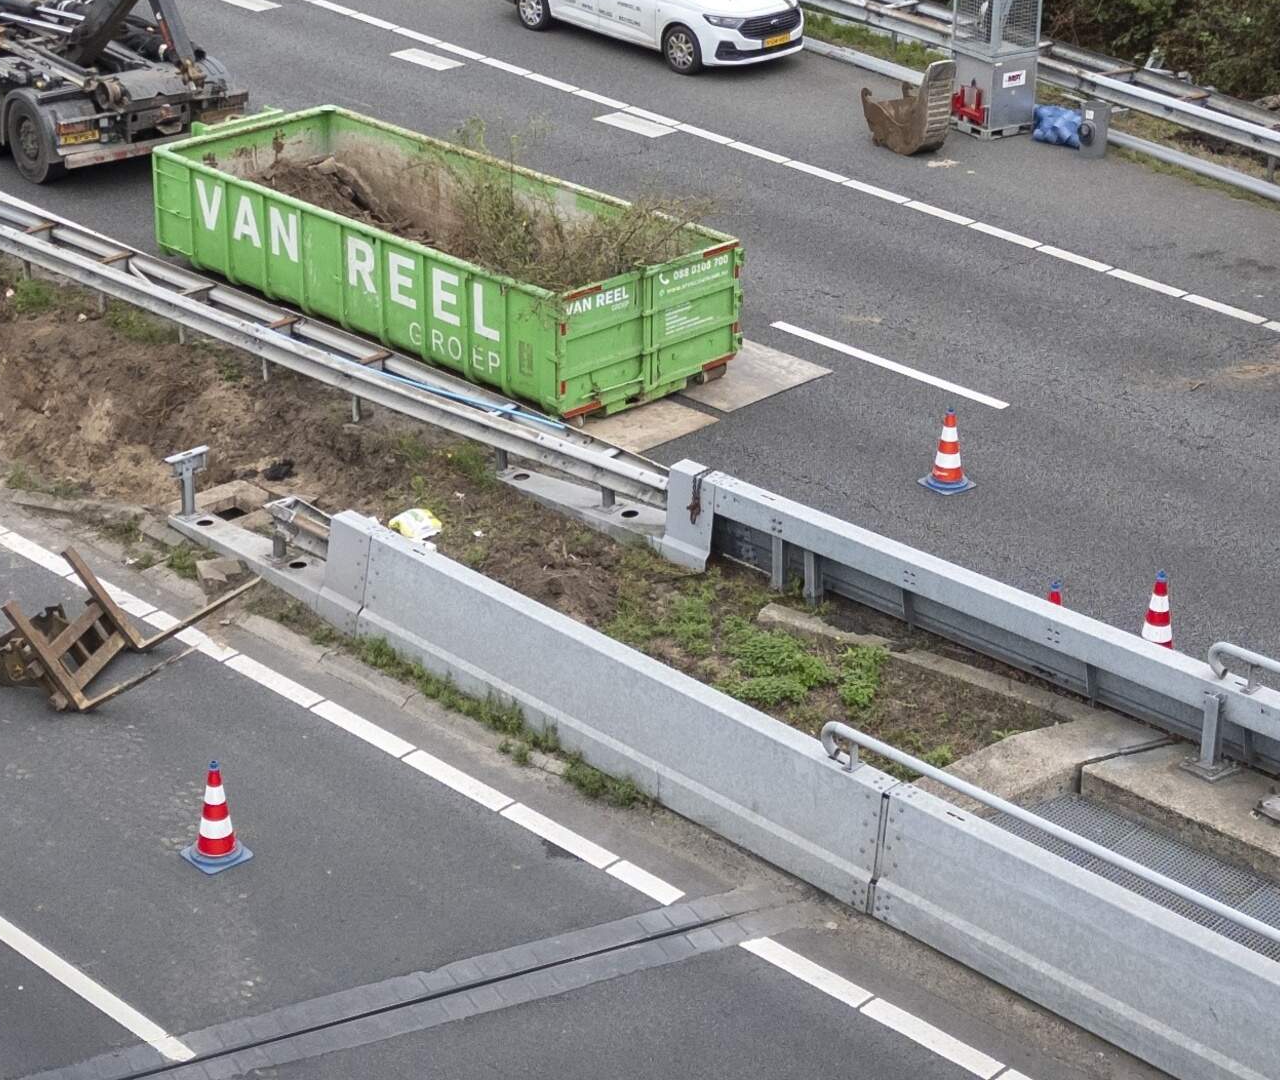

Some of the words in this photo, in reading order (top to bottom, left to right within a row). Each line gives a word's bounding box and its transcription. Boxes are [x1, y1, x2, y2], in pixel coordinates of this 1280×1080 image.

[196, 178, 299, 263] VAN
[346, 235, 500, 343] REEL
[566, 297, 592, 316] VAN
[596, 286, 630, 308] REEL
[409, 322, 501, 374] GROEP
